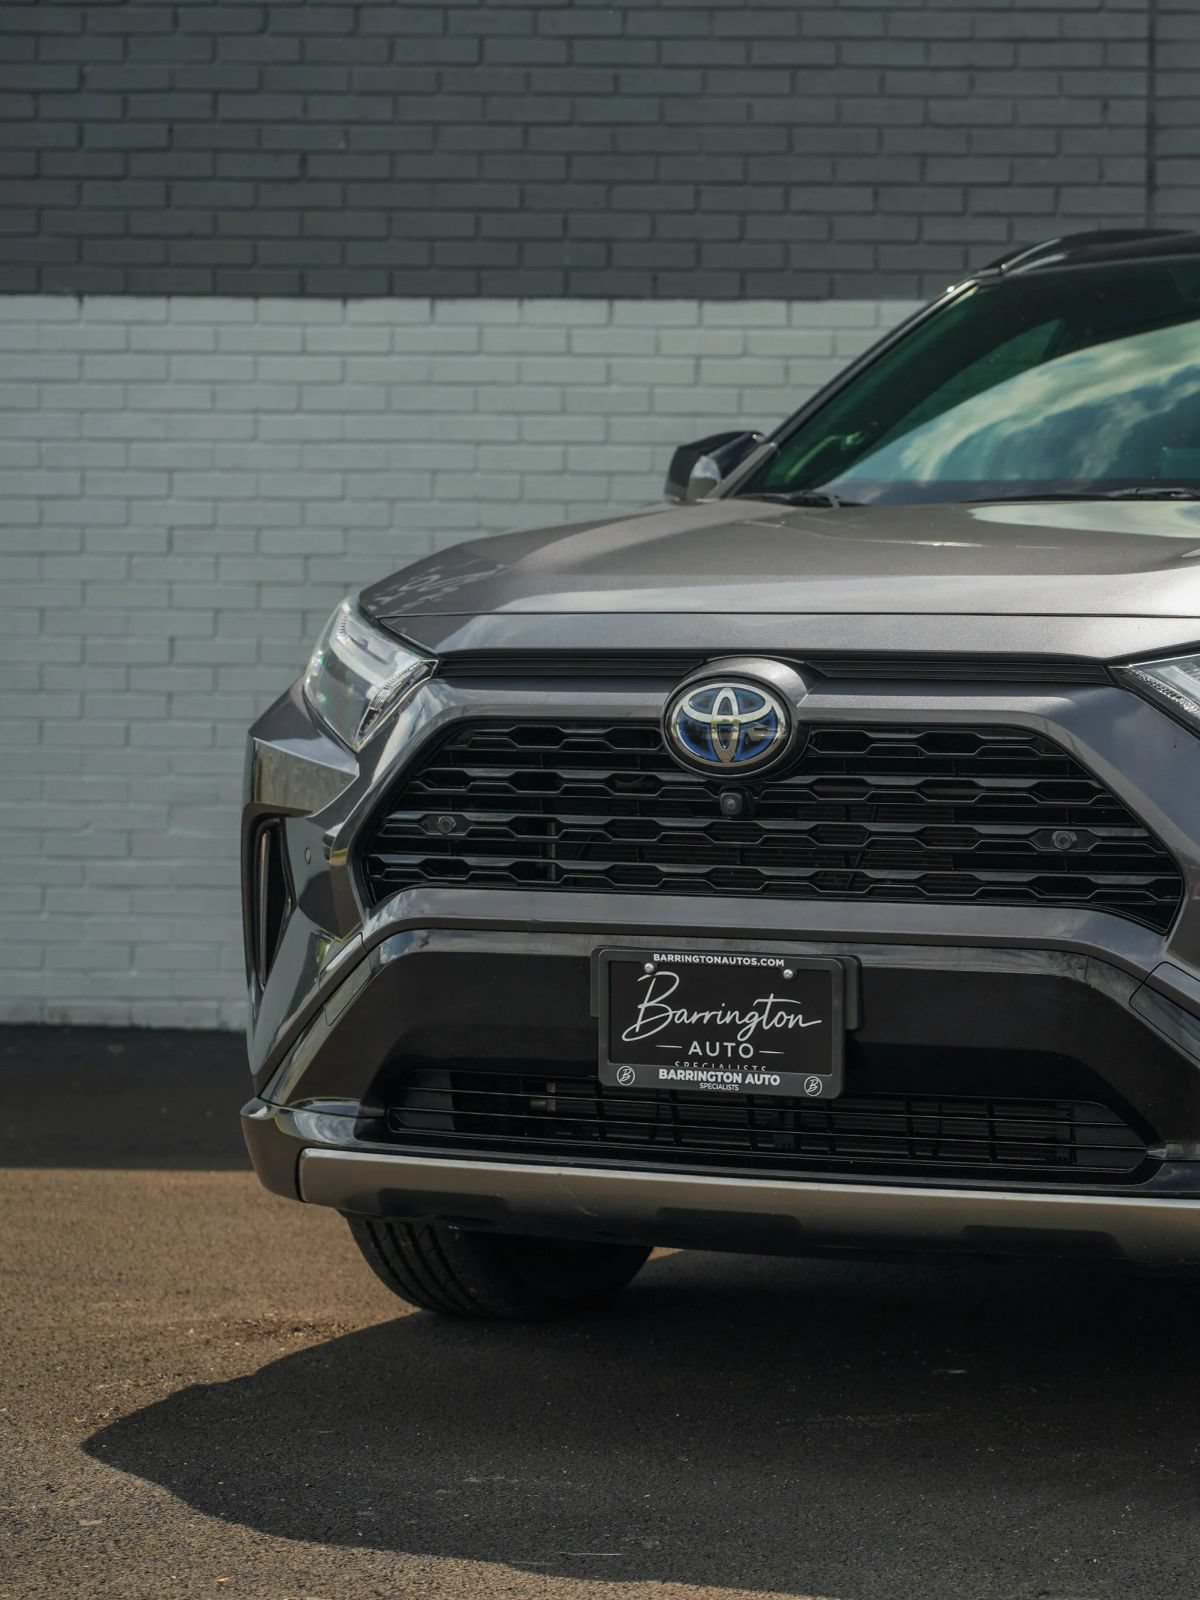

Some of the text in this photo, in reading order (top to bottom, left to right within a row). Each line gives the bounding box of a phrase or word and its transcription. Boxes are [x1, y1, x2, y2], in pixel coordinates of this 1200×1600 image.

[653, 953, 785, 967] BARRINGTONAUTOS.COM
[621, 971, 822, 1042] Barrington
[688, 1041, 754, 1059] AUTO
[659, 1068, 780, 1086] BARRINGTON AUTO
[699, 1082, 739, 1091] SPECIALISTS
